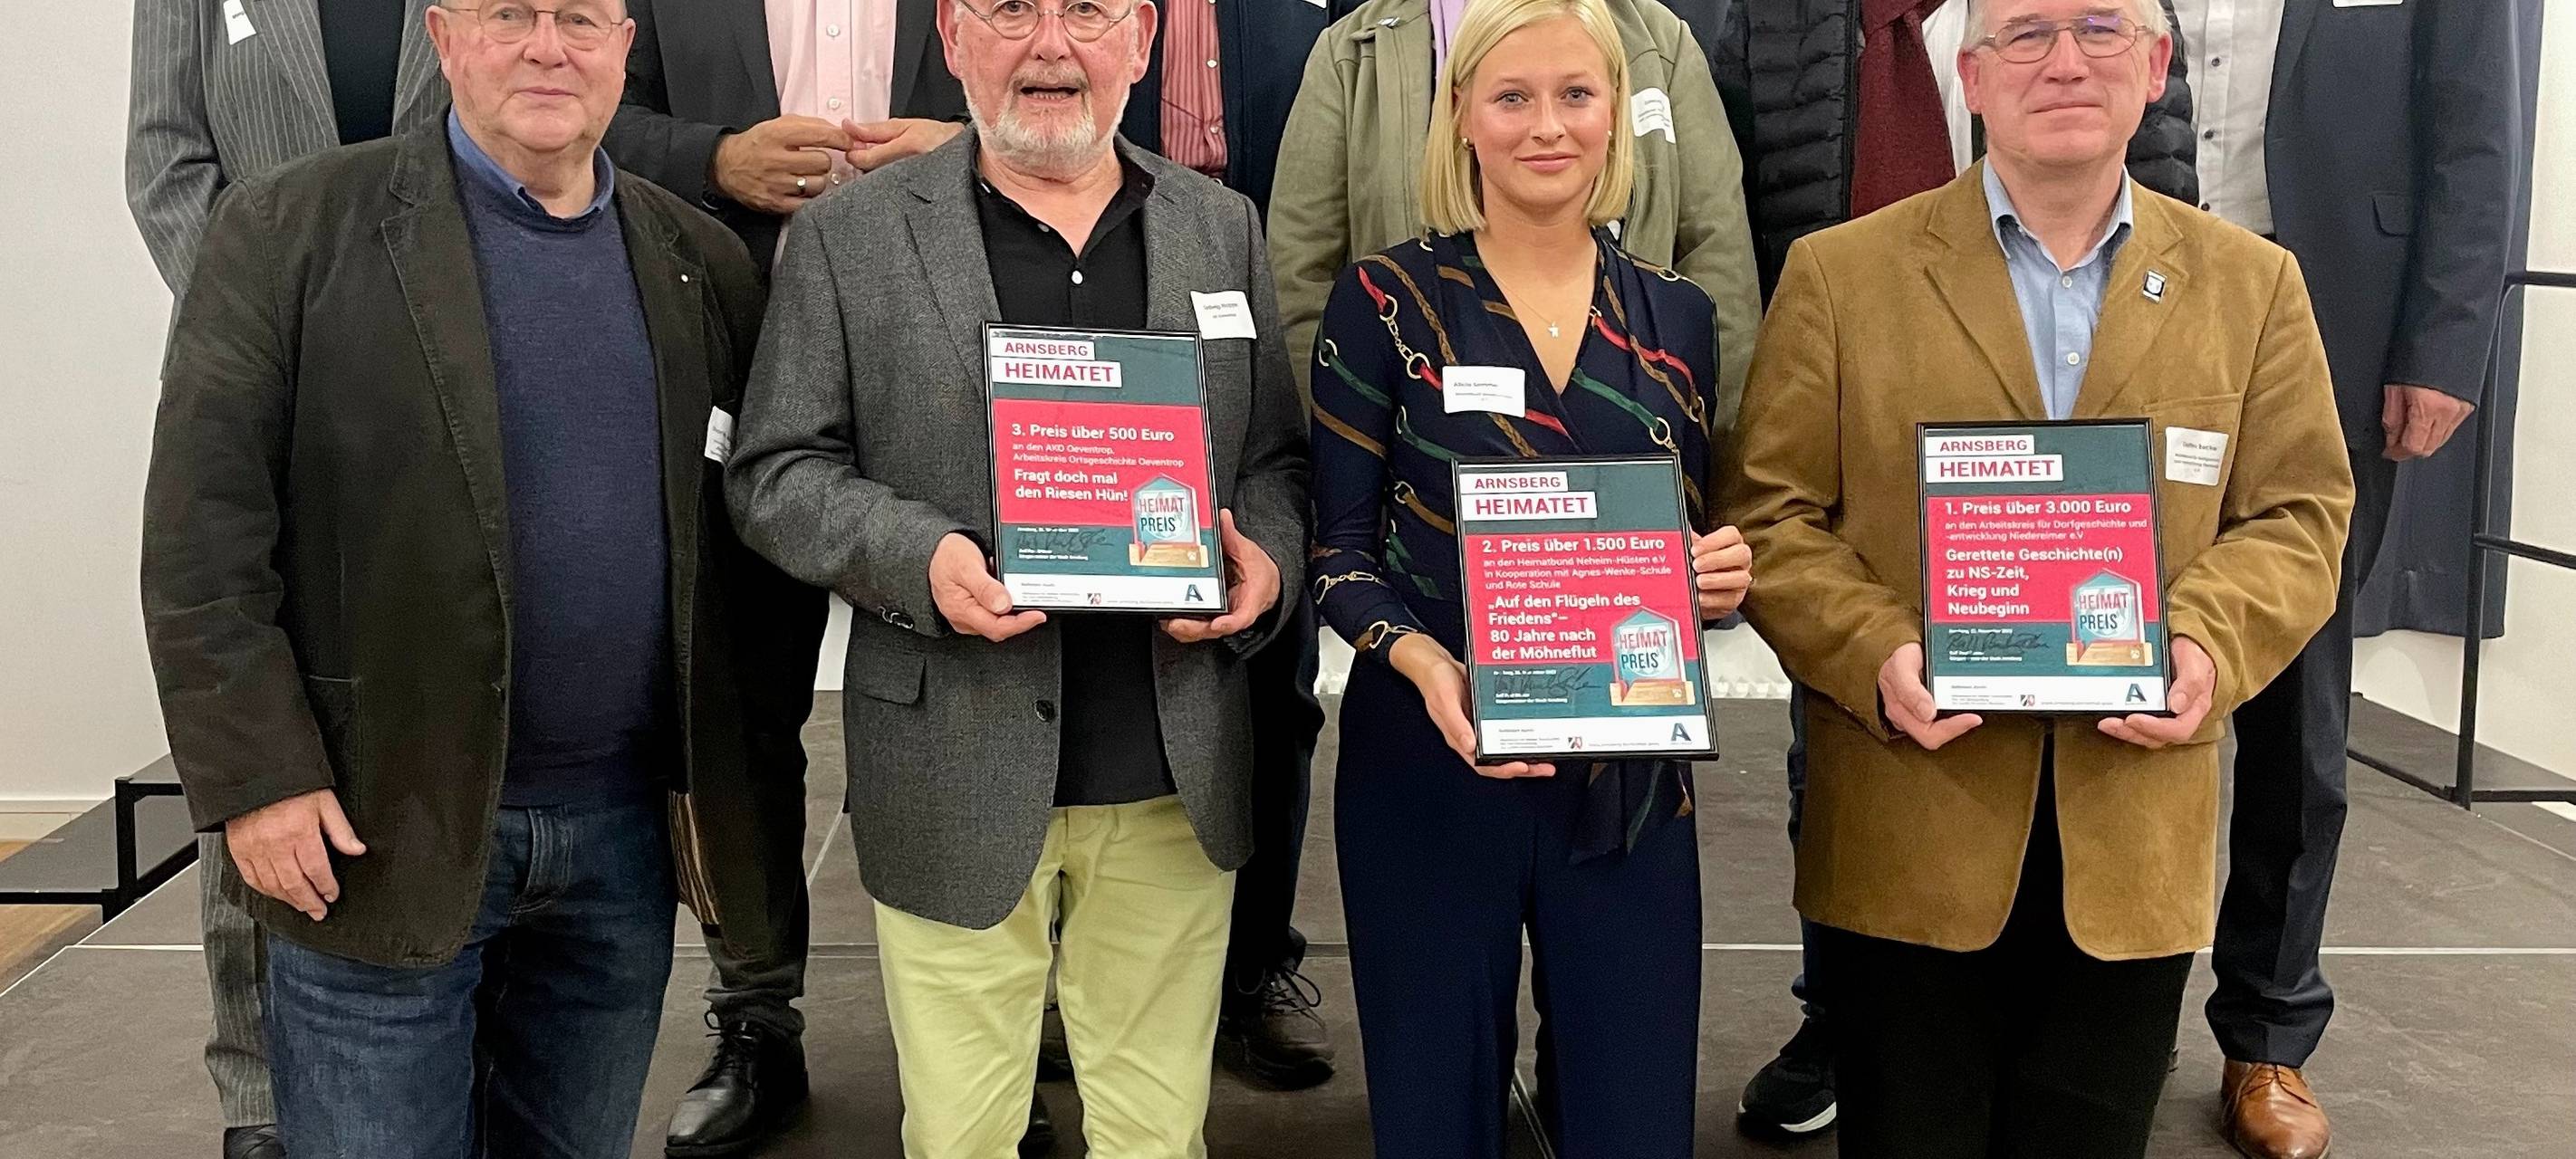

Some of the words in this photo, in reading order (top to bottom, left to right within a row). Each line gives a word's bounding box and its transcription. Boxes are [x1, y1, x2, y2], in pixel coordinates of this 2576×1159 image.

[1004, 342, 1088, 356] ARNSBERG
[1005, 362, 1113, 382] HEIMATET
[1012, 423, 1025, 436] 3.
[1030, 424, 1068, 437] Preis
[1072, 426, 1105, 439] über
[1109, 427, 1137, 440] 500
[1141, 428, 1175, 442] Euro
[1026, 443, 1043, 451] den
[1940, 439, 2028, 452] ARNSBERG
[1014, 454, 1067, 463] Arbeitskreis
[1069, 455, 1137, 465] Ortsgeschichte
[1139, 457, 1185, 468] Oeventrop
[1940, 460, 2054, 477] HEIMATET
[1014, 468, 1051, 484] Fragt
[1054, 471, 1088, 484] doch
[1091, 472, 1118, 484] mal
[1475, 476, 1561, 489] ARNSBERG
[1015, 485, 1042, 498] den
[1045, 486, 1092, 500] Riesen
[1095, 488, 1129, 502] Hün!
[1139, 498, 1185, 512] HEIMAT
[1475, 497, 1588, 515] HEIMATET
[1945, 502, 1957, 515] 1.
[1962, 501, 2002, 514] Preis
[2006, 501, 2042, 514] über
[2045, 501, 2091, 513] 3.000
[2095, 500, 2131, 513] Euro
[1140, 517, 1176, 532] PREIS
[1959, 522, 1976, 530] den
[1979, 521, 2035, 530] Arbeitskreis
[2038, 521, 2051, 529] für
[2053, 520, 2126, 531] Dorfgeschichte
[2129, 519, 2147, 528] und
[2010, 532, 2066, 541] Niedereimer
[1482, 539, 1497, 553] 2.
[1501, 539, 1540, 552] Preis
[1544, 538, 1579, 551] über
[1583, 537, 1626, 551] 1.500
[1630, 536, 1665, 550] Euro
[1517, 557, 1574, 566] Heimatbund
[1946, 549, 2014, 561] Gerettete
[2019, 547, 2123, 562] Geschichte(n)
[1495, 570, 1552, 579] Kooperation
[1553, 569, 1569, 577] mit
[1946, 569, 1965, 579] zu
[1968, 565, 2029, 580] NS-Zeit,
[1485, 580, 1504, 589] und
[1505, 580, 1527, 589] Rote
[1529, 580, 1562, 589] Schule
[1946, 584, 1987, 599] Krieg
[1991, 583, 2019, 597] und
[1523, 594, 1551, 608] den
[1555, 593, 1610, 610] Flügeln
[1613, 592, 1640, 606] des
[2079, 592, 2129, 609] HEIMAT
[1947, 601, 2029, 618] Neubeginn
[2080, 613, 2118, 629] PREIS
[1490, 629, 1510, 643] 80
[1514, 628, 1556, 642] Jahre
[1560, 627, 1596, 641] nach
[1620, 630, 1667, 649] HEIMAT
[1492, 647, 1516, 660] der
[1519, 645, 1597, 659] Möhneflut
[1621, 652, 1658, 669] PREIS
